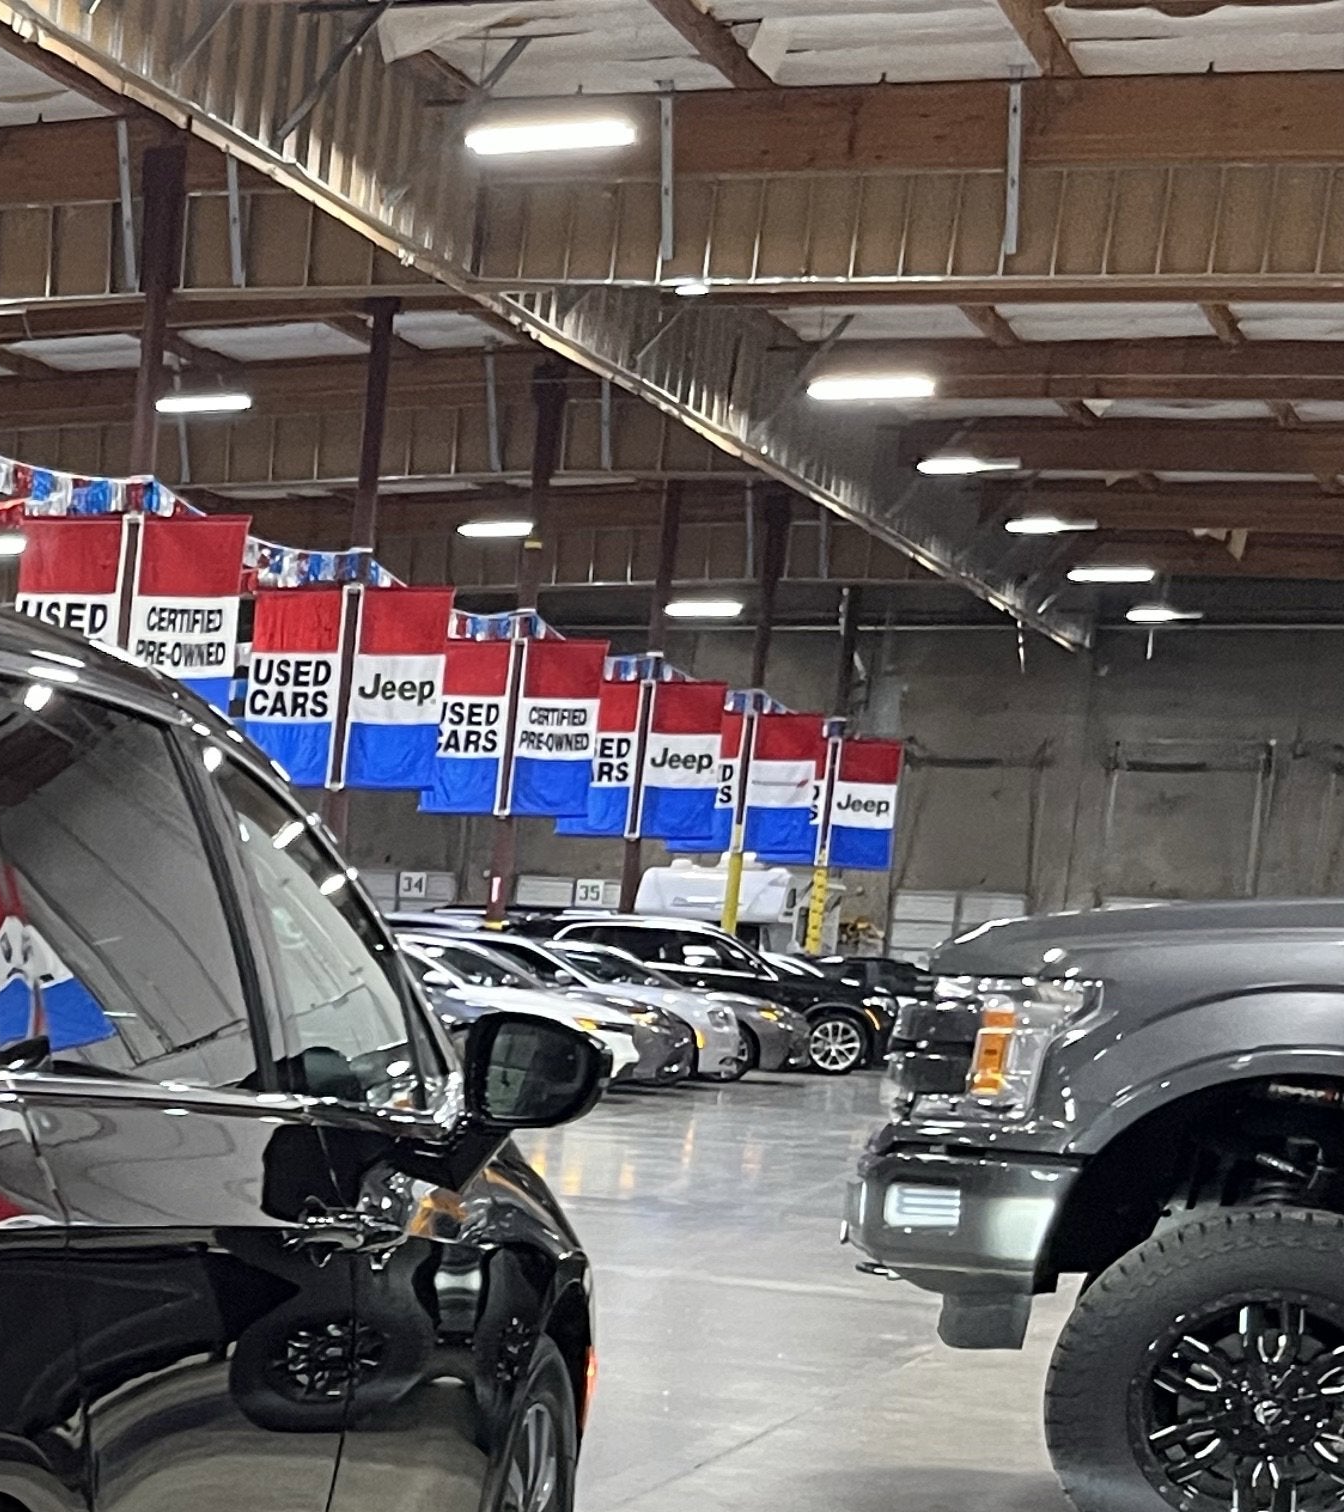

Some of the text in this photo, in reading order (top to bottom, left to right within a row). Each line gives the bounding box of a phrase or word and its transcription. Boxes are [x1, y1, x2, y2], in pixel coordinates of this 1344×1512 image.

[146, 606, 222, 633] CERTIFIED
[136, 639, 226, 667] PRE-OWNED
[253, 659, 331, 686] USED
[358, 673, 435, 706] Jeep
[249, 689, 328, 717] CARS
[529, 706, 587, 726] CERTIFIED
[519, 731, 589, 752] PRE-OWNED
[599, 738, 631, 759] ED
[650, 747, 713, 774] Jeep
[597, 762, 629, 783] RS
[836, 794, 889, 816] Jeep
[403, 877, 423, 893] 34
[579, 885, 600, 901] 35
